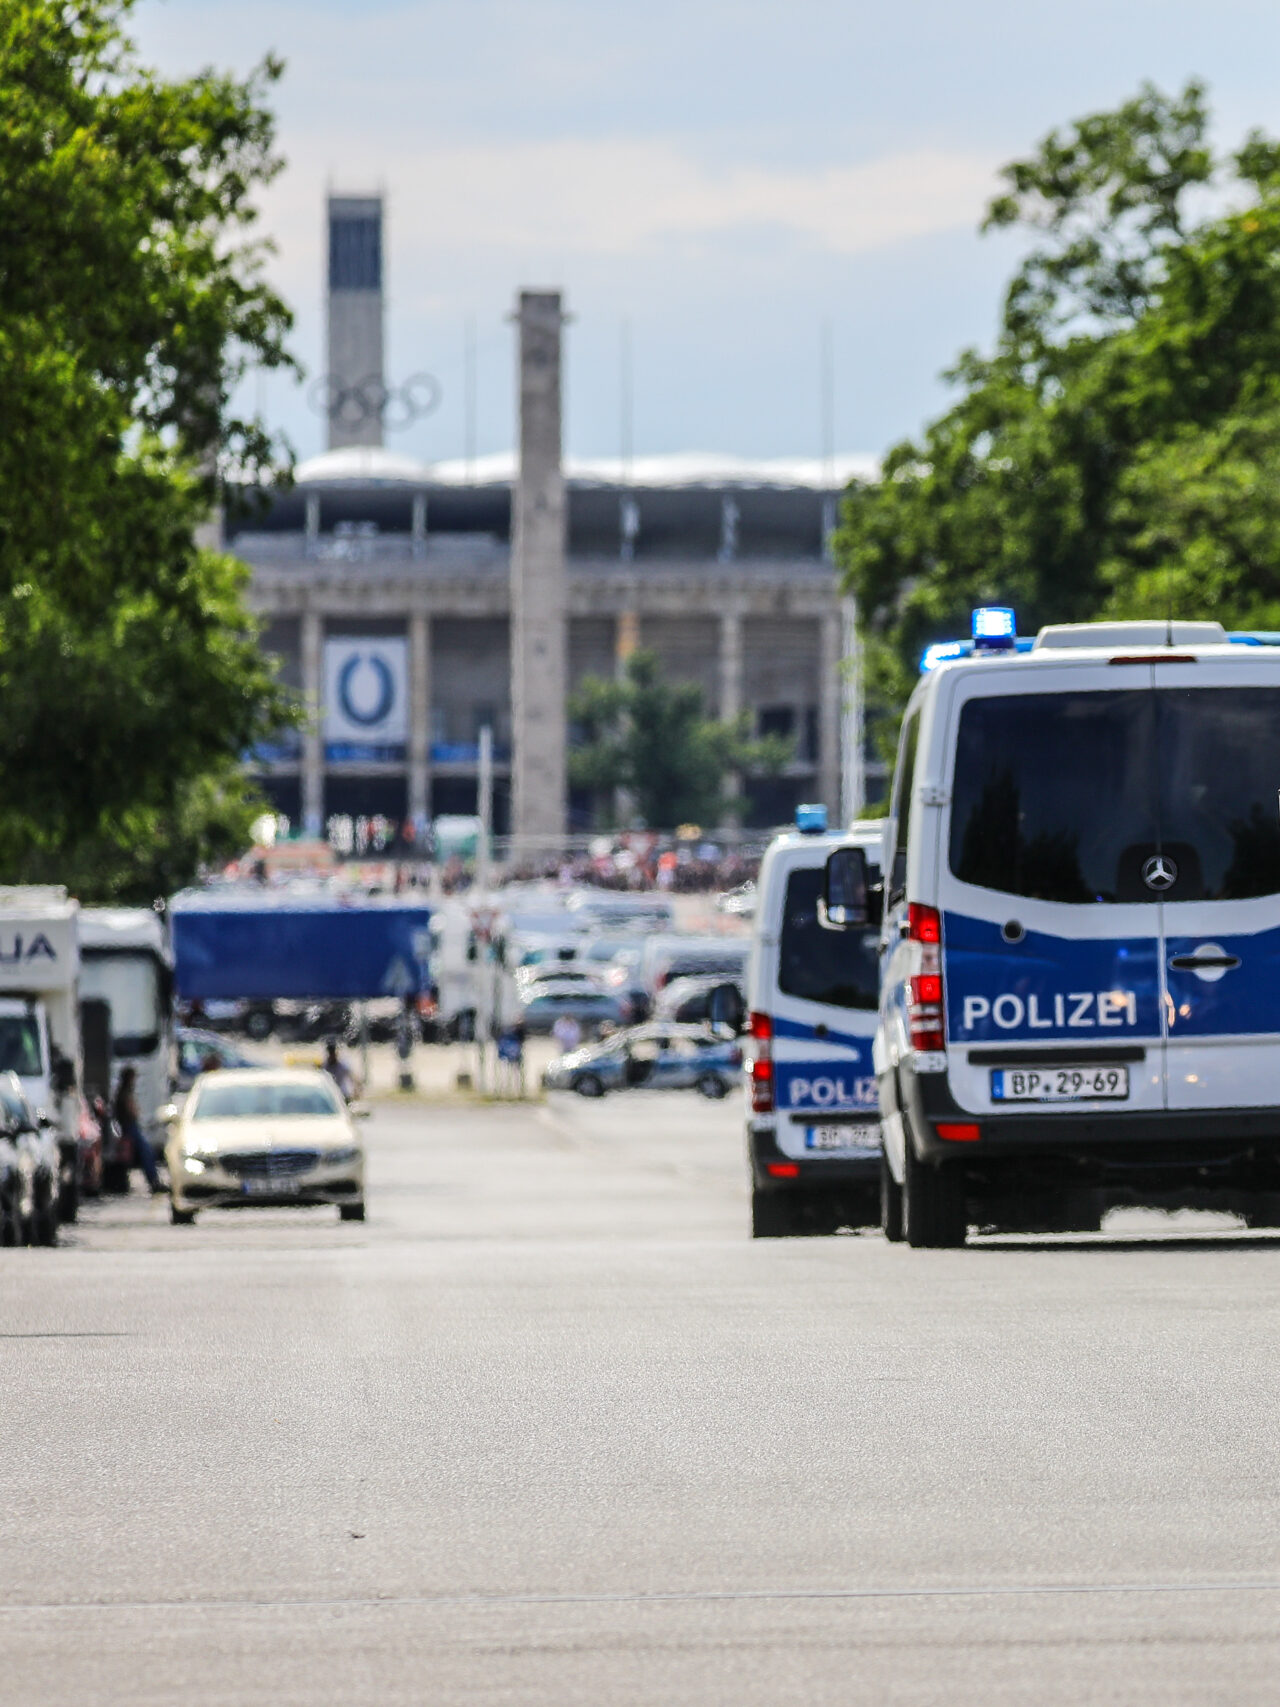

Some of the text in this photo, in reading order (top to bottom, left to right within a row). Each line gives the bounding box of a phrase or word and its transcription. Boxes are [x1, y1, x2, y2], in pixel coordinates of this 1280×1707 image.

[963, 990, 1137, 1030] POLIZEI
[1011, 1072, 1040, 1095] BP
[1057, 1071, 1119, 1095] 29-69
